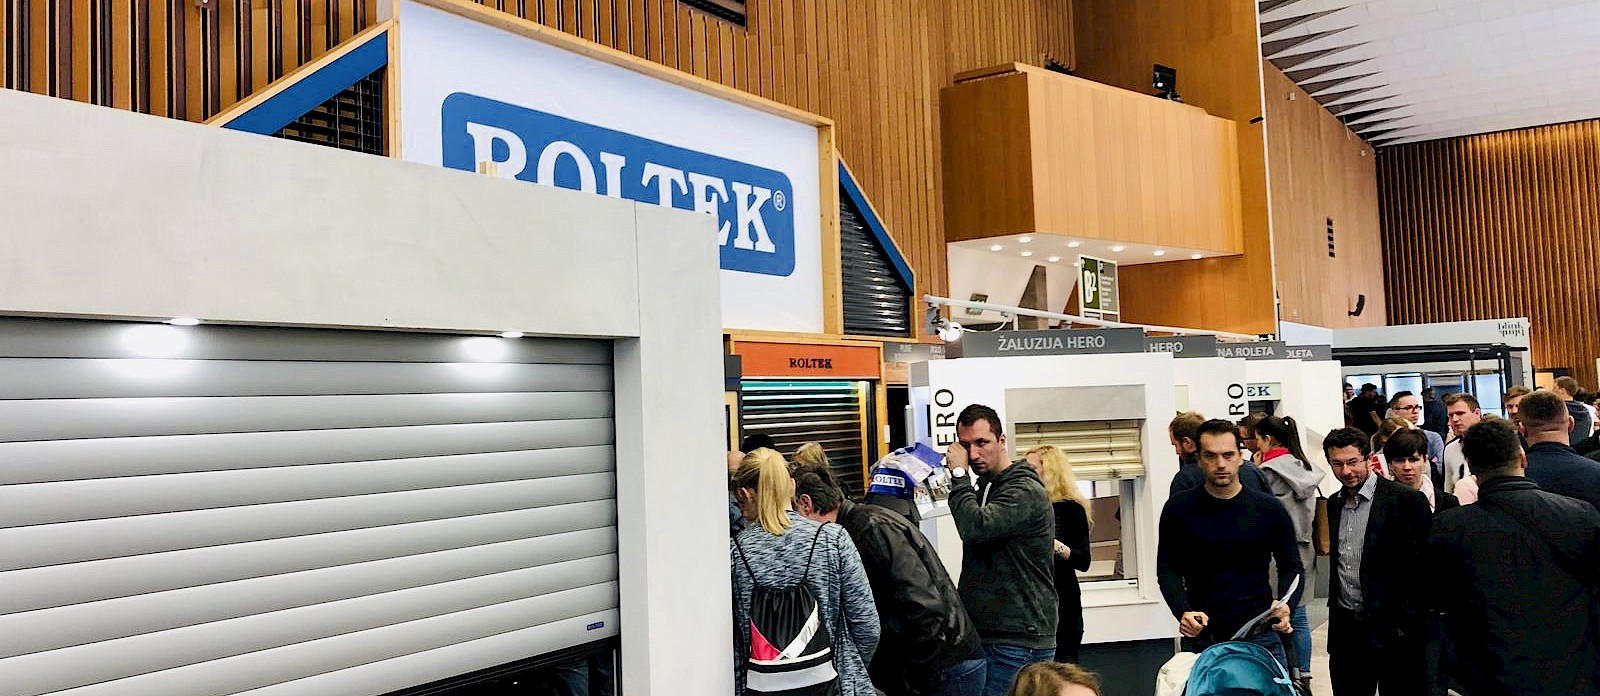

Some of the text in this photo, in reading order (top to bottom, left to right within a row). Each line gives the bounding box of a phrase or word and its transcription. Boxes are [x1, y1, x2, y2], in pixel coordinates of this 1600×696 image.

[998, 335, 1105, 351] ŽALUZIJA HERO
[1150, 341, 1184, 353] HERO
[1235, 346, 1275, 357] ROLETA
[789, 357, 833, 369] ROLTEK
[934, 388, 956, 448] ERO
